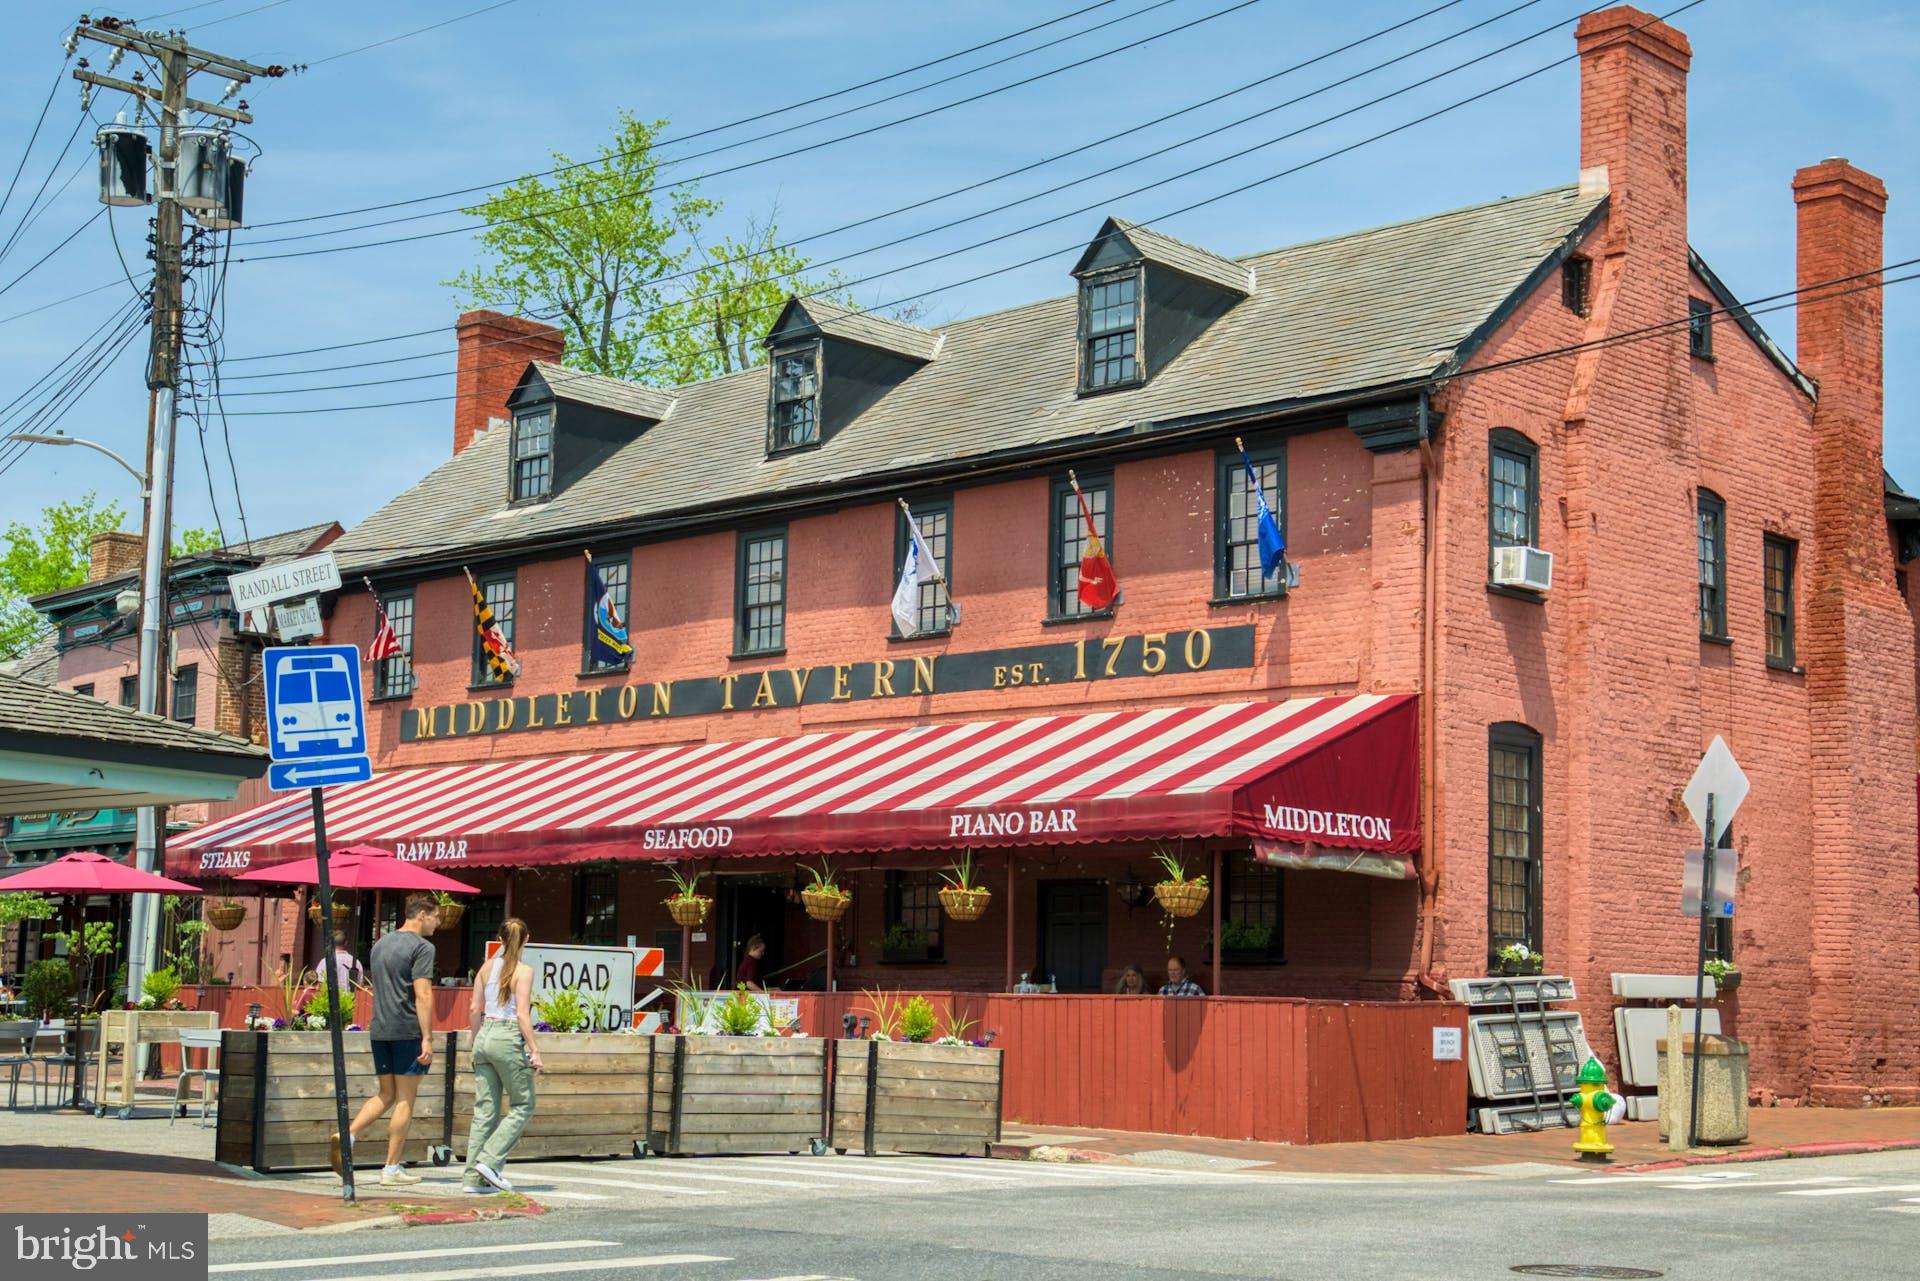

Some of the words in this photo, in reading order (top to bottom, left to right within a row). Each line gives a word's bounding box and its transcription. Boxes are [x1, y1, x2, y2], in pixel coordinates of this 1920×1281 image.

[239, 573, 291, 600] RANDALL
[293, 563, 331, 587] STREET
[278, 610, 298, 628] MARKET
[415, 680, 674, 739] MIDDLETON
[719, 655, 938, 710] TAVERN
[993, 662, 1050, 688] EST.
[1073, 628, 1212, 680] 1750
[949, 811, 1024, 837] PIANO
[1029, 809, 1078, 833] BAR
[1264, 804, 1392, 841] MIDDLETON
[396, 841, 434, 862] RAW
[434, 840, 468, 860] BAR
[643, 826, 733, 850] SEAFOOD
[200, 850, 251, 870] STEAKS
[543, 961, 610, 991] ROAD
